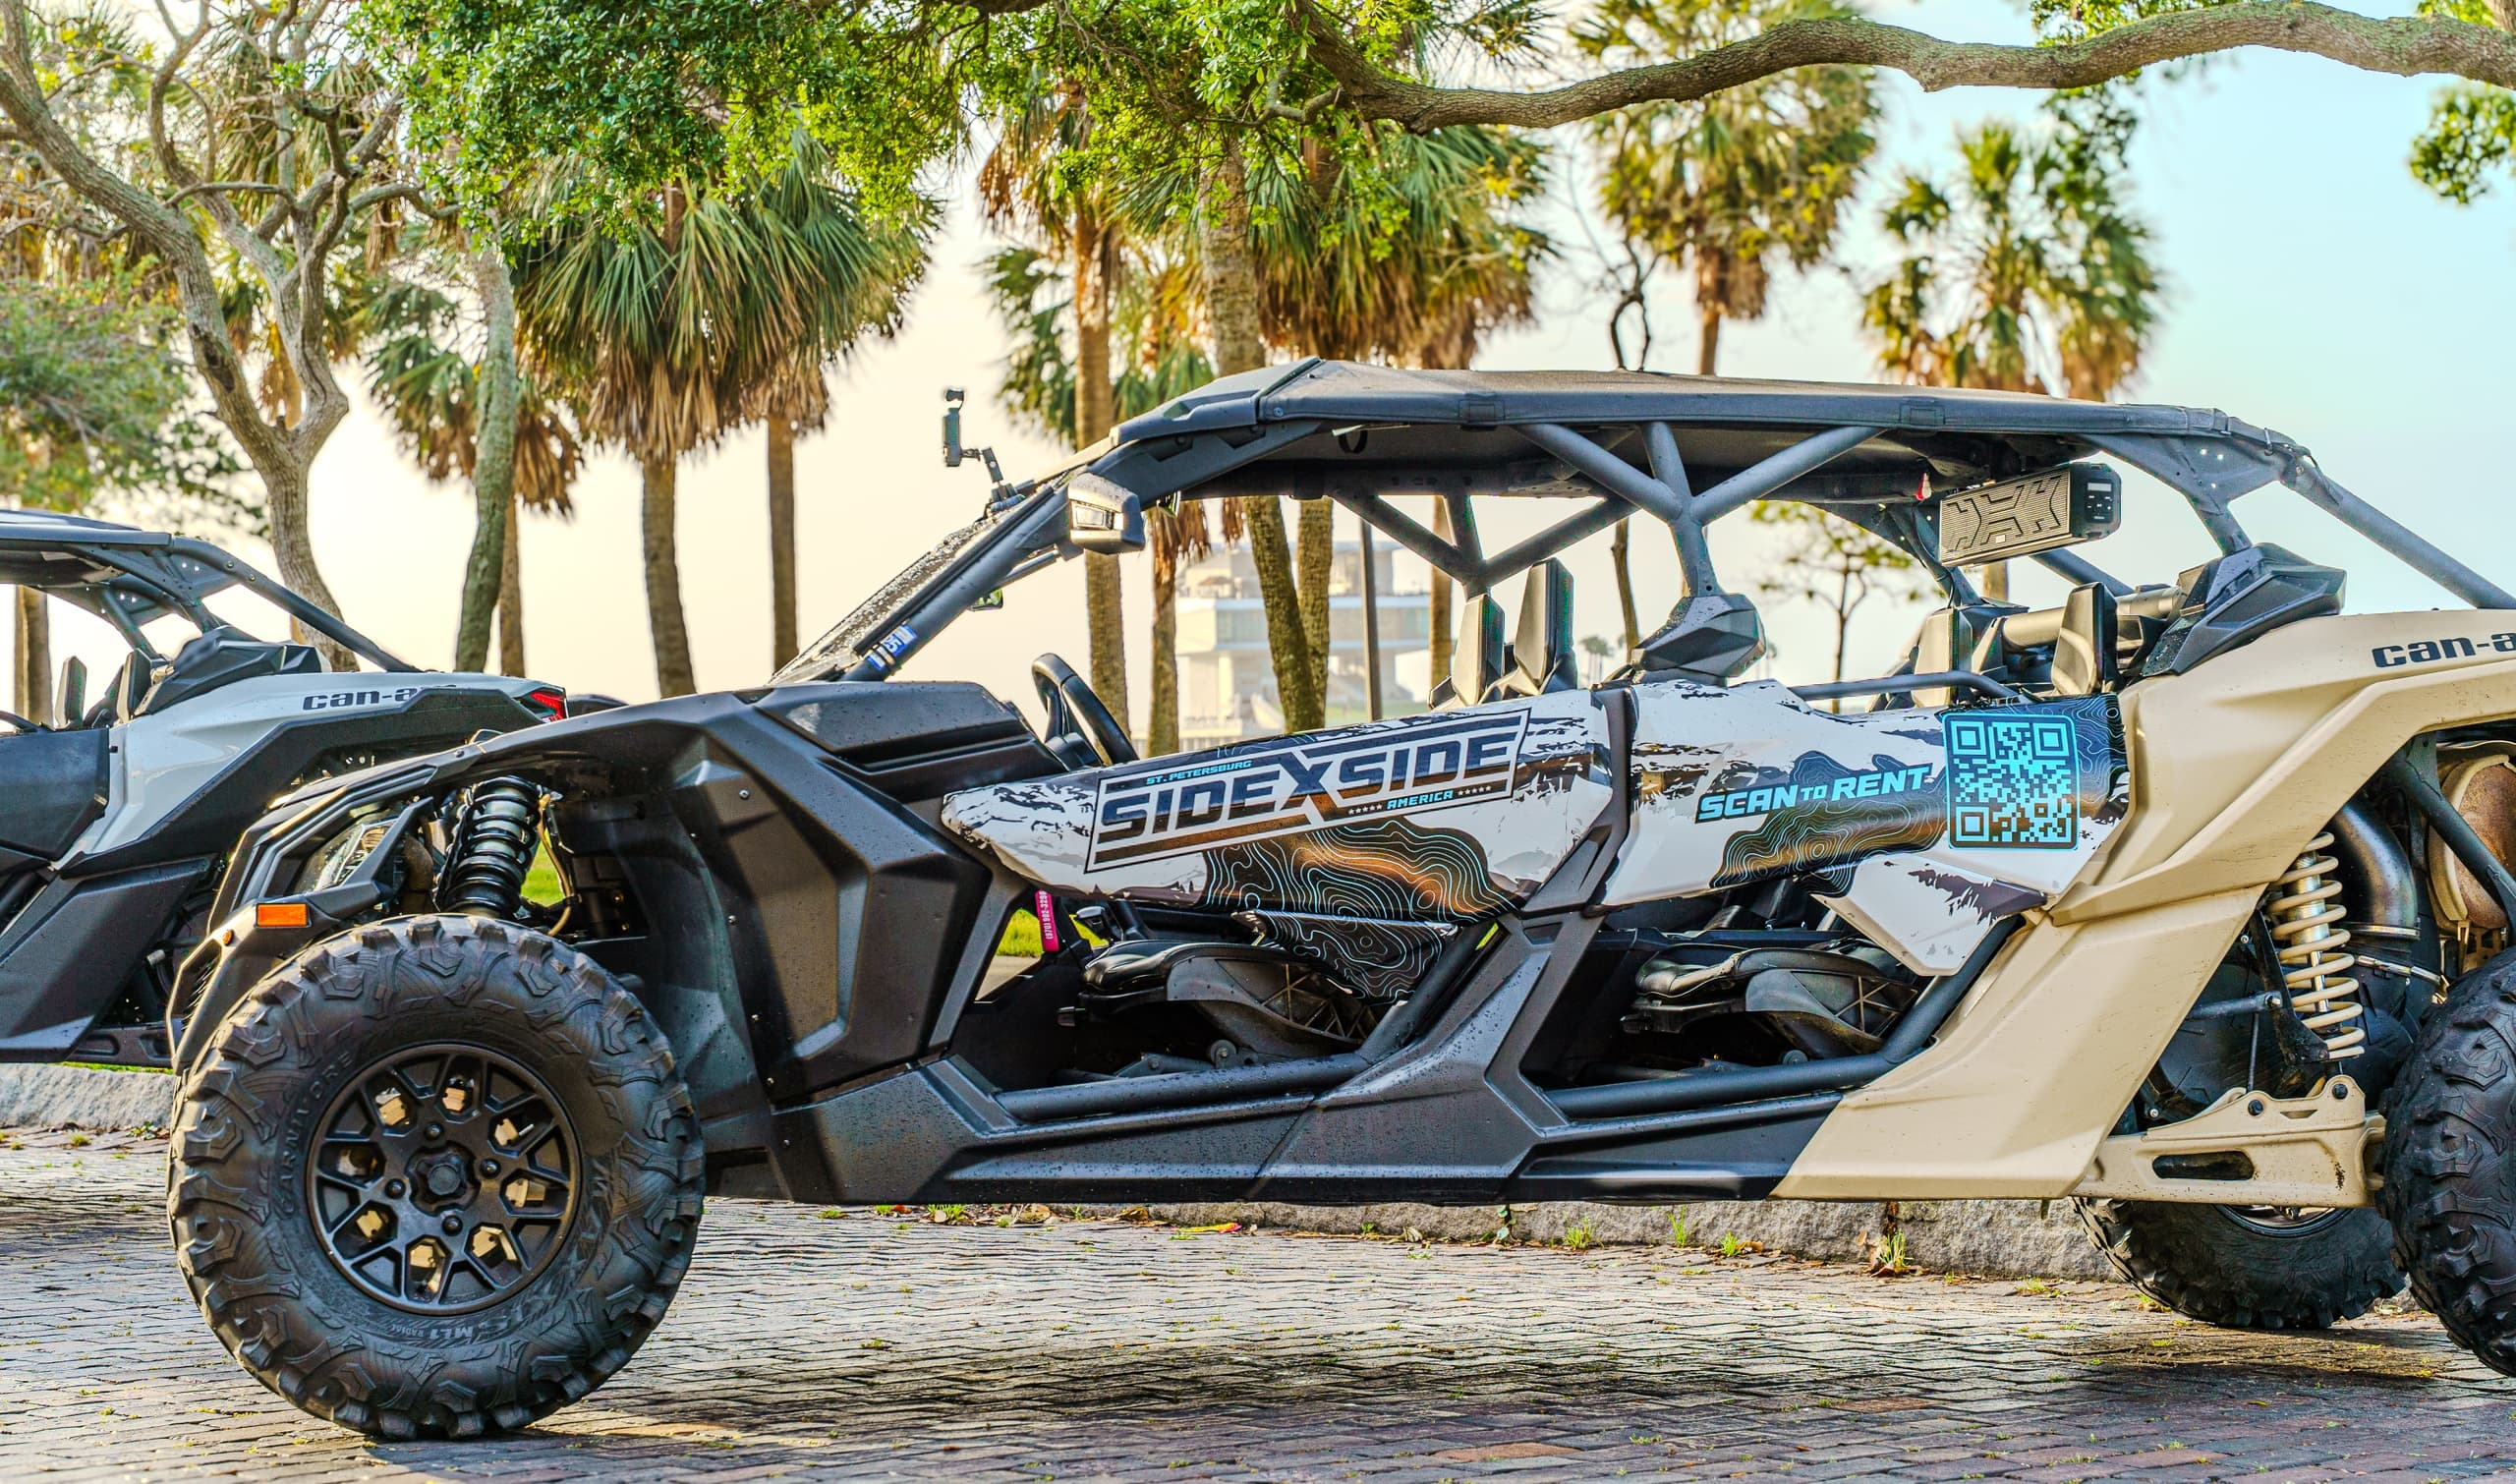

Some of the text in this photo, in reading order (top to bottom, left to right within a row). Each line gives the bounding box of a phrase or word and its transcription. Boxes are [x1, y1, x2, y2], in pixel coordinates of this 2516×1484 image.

[303, 685, 456, 711] can-a
[1146, 760, 1252, 785] ST. PETERSBURG
[1097, 731, 1518, 843] SIDEXSIDE
[1387, 790, 1454, 809] AMERICA
[1698, 767, 1932, 820] SCAN TO RENT
[429, 1326, 474, 1340] ML1
